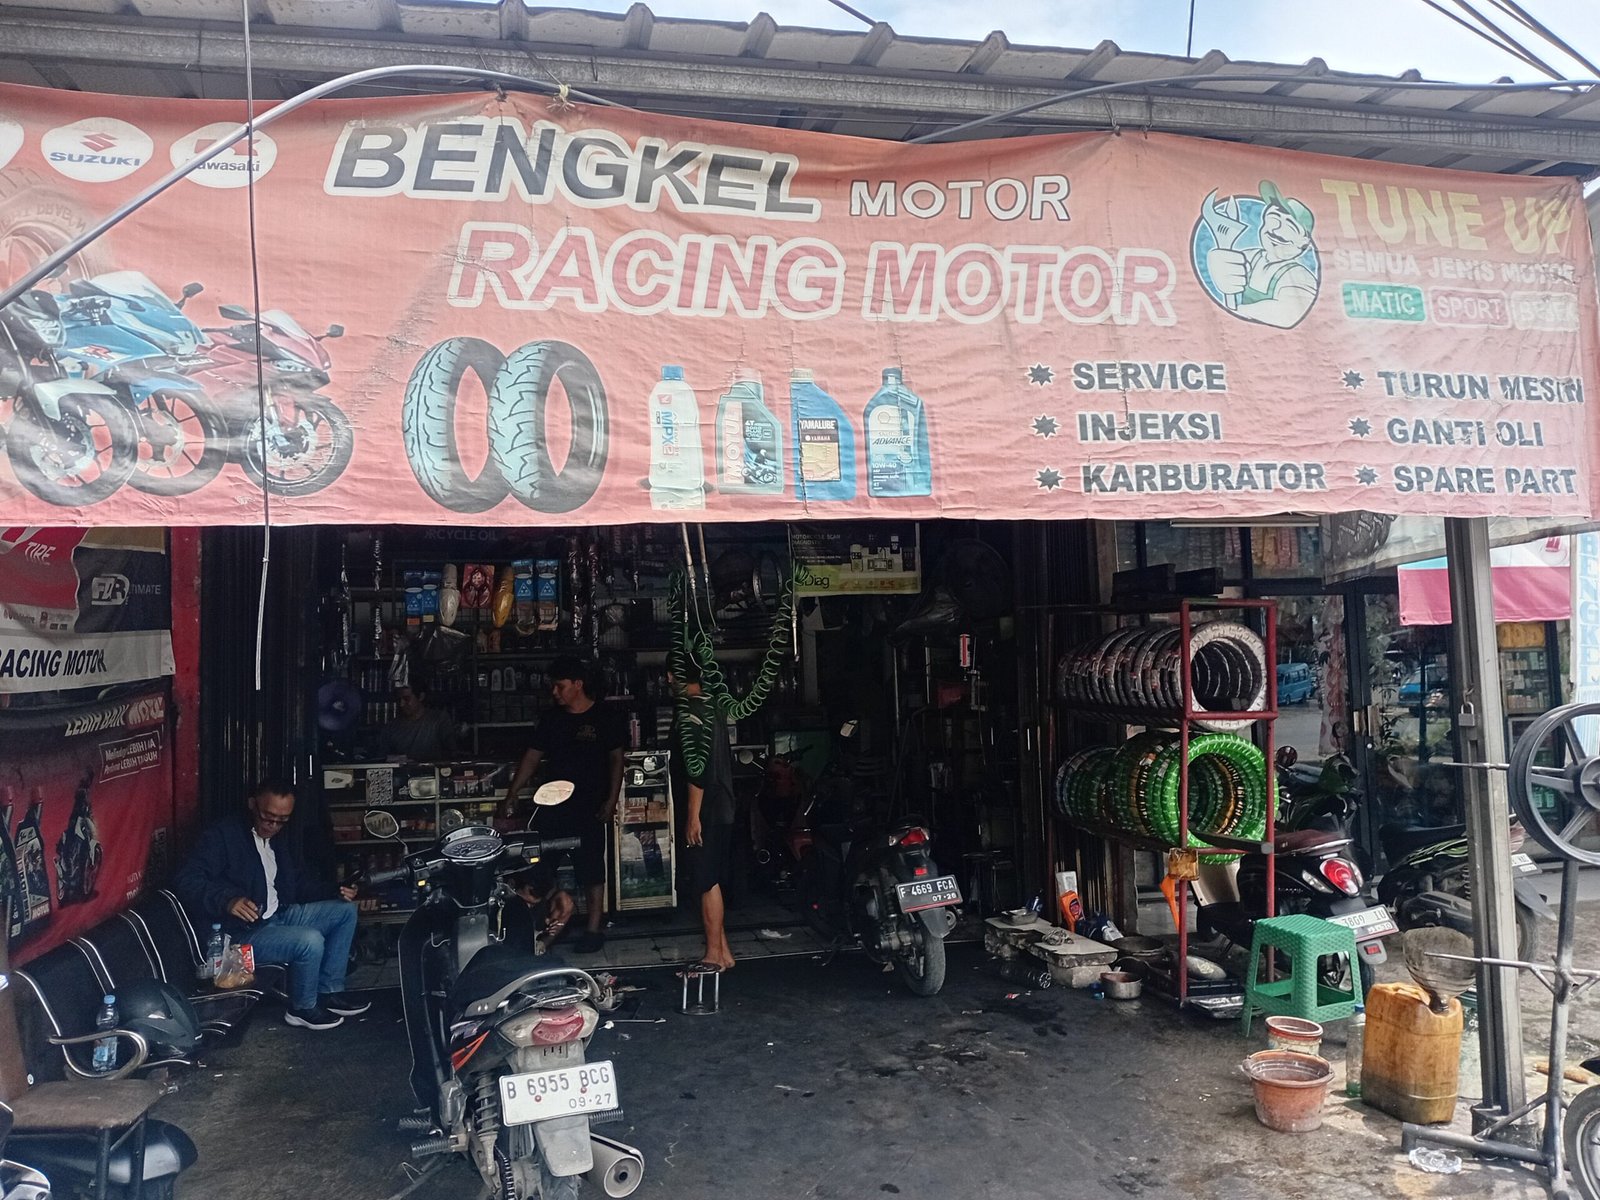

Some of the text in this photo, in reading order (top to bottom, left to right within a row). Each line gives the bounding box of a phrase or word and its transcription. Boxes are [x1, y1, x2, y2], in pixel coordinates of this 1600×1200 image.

[50, 152, 141, 167] SUZUKI
[186, 159, 260, 172] awasaki
[326, 117, 1070, 221] BENGKEL MOTOR
[1320, 178, 1571, 255] TUNE UP
[447, 221, 1178, 327] RACING MOTOR
[1334, 250, 1421, 277] SEMUA
[1428, 257, 1496, 282] JENIS
[1351, 289, 1416, 315] MATIC
[1437, 297, 1501, 321] SPORT
[1072, 362, 1227, 391] SERVICE
[1377, 371, 1585, 403] TURUN MESIN
[800, 420, 836, 430] YAMALUBE
[1077, 412, 1223, 442] INJEKSI
[1386, 417, 1544, 447] GANTI OLI
[727, 402, 741, 482] MOTUL
[872, 436, 912, 446] ADVANCE
[1081, 462, 1328, 493] KARBURATOR
[1394, 465, 1577, 495] SPARE PART
[25, 541, 57, 565] TIRE
[0, 648, 107, 678] ACING MOTOR
[99, 704, 129, 730] BAIK
[900, 880, 954, 898] F 4669 FCA
[506, 1066, 610, 1100] B 6955 BCG
